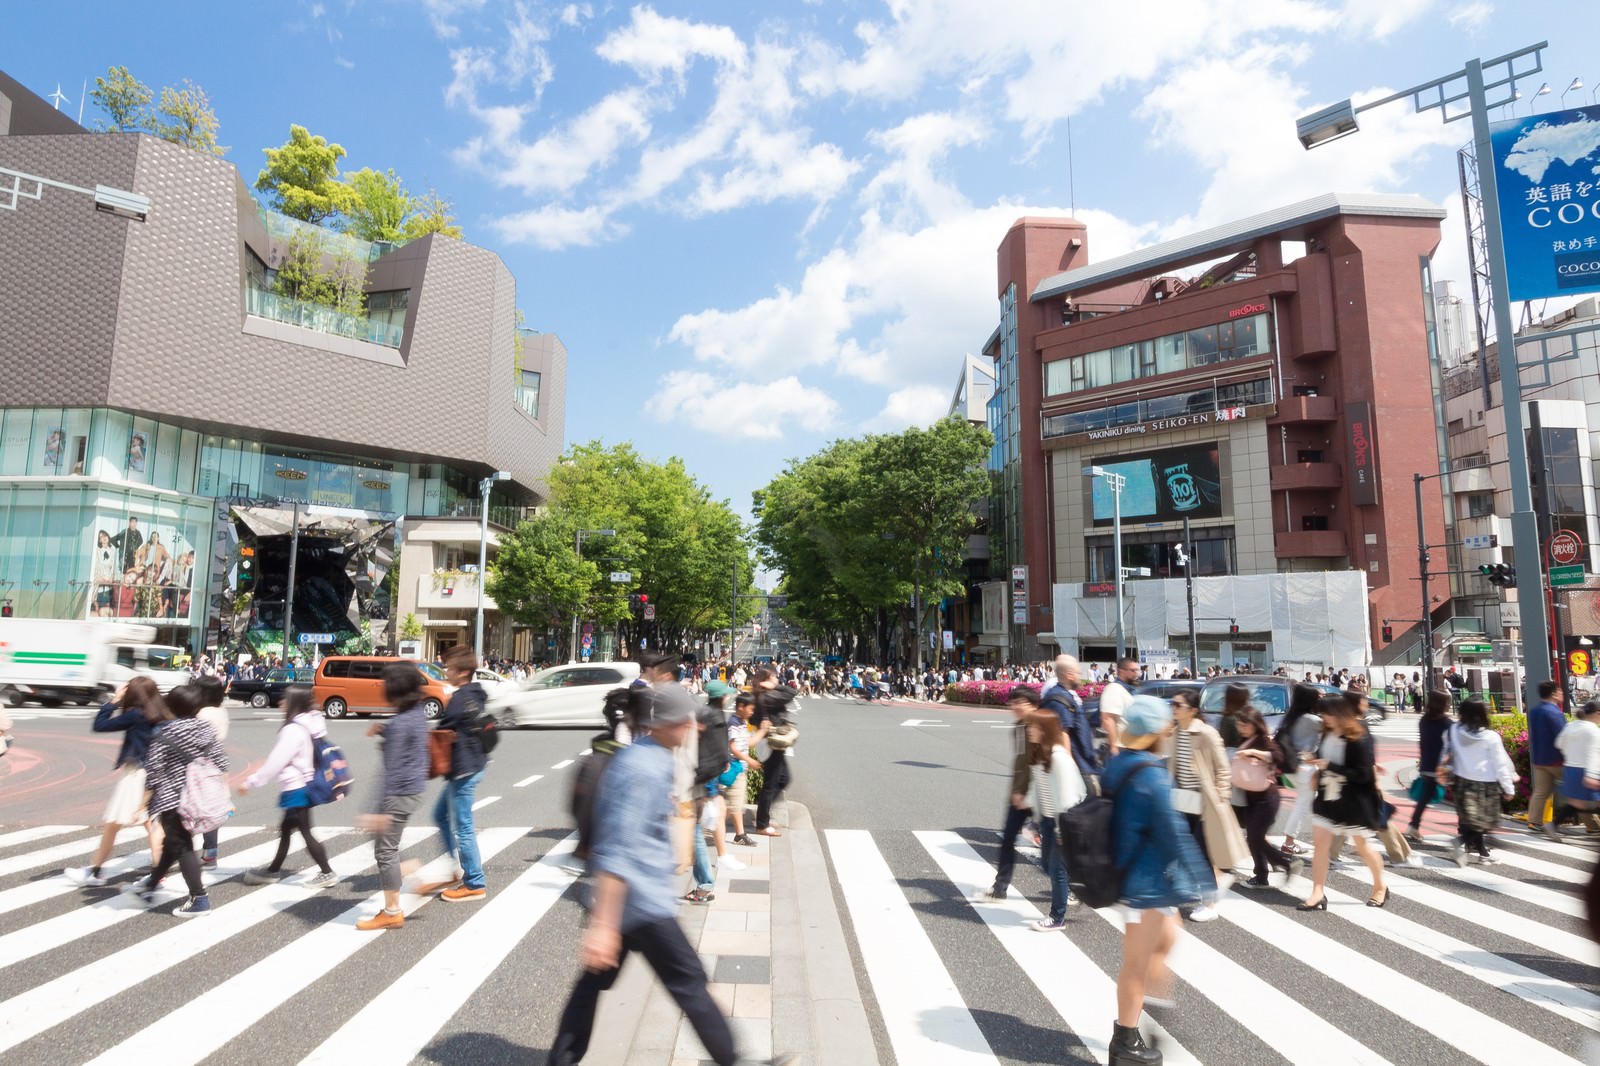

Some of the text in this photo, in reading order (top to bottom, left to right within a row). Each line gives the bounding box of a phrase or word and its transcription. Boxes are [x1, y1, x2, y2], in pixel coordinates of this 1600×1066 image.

[1525, 181, 1600, 206] 英語を
[1229, 303, 1265, 318] BROOKS
[1088, 407, 1246, 440] YAKINIKU dining SEIKO-EN 焼肉
[1352, 422, 1369, 468] BROOKS
[277, 470, 307, 480] KEEN
[277, 495, 315, 505] TOKYU
[1553, 543, 1575, 556] 消火栓
[1570, 652, 1587, 675] S
